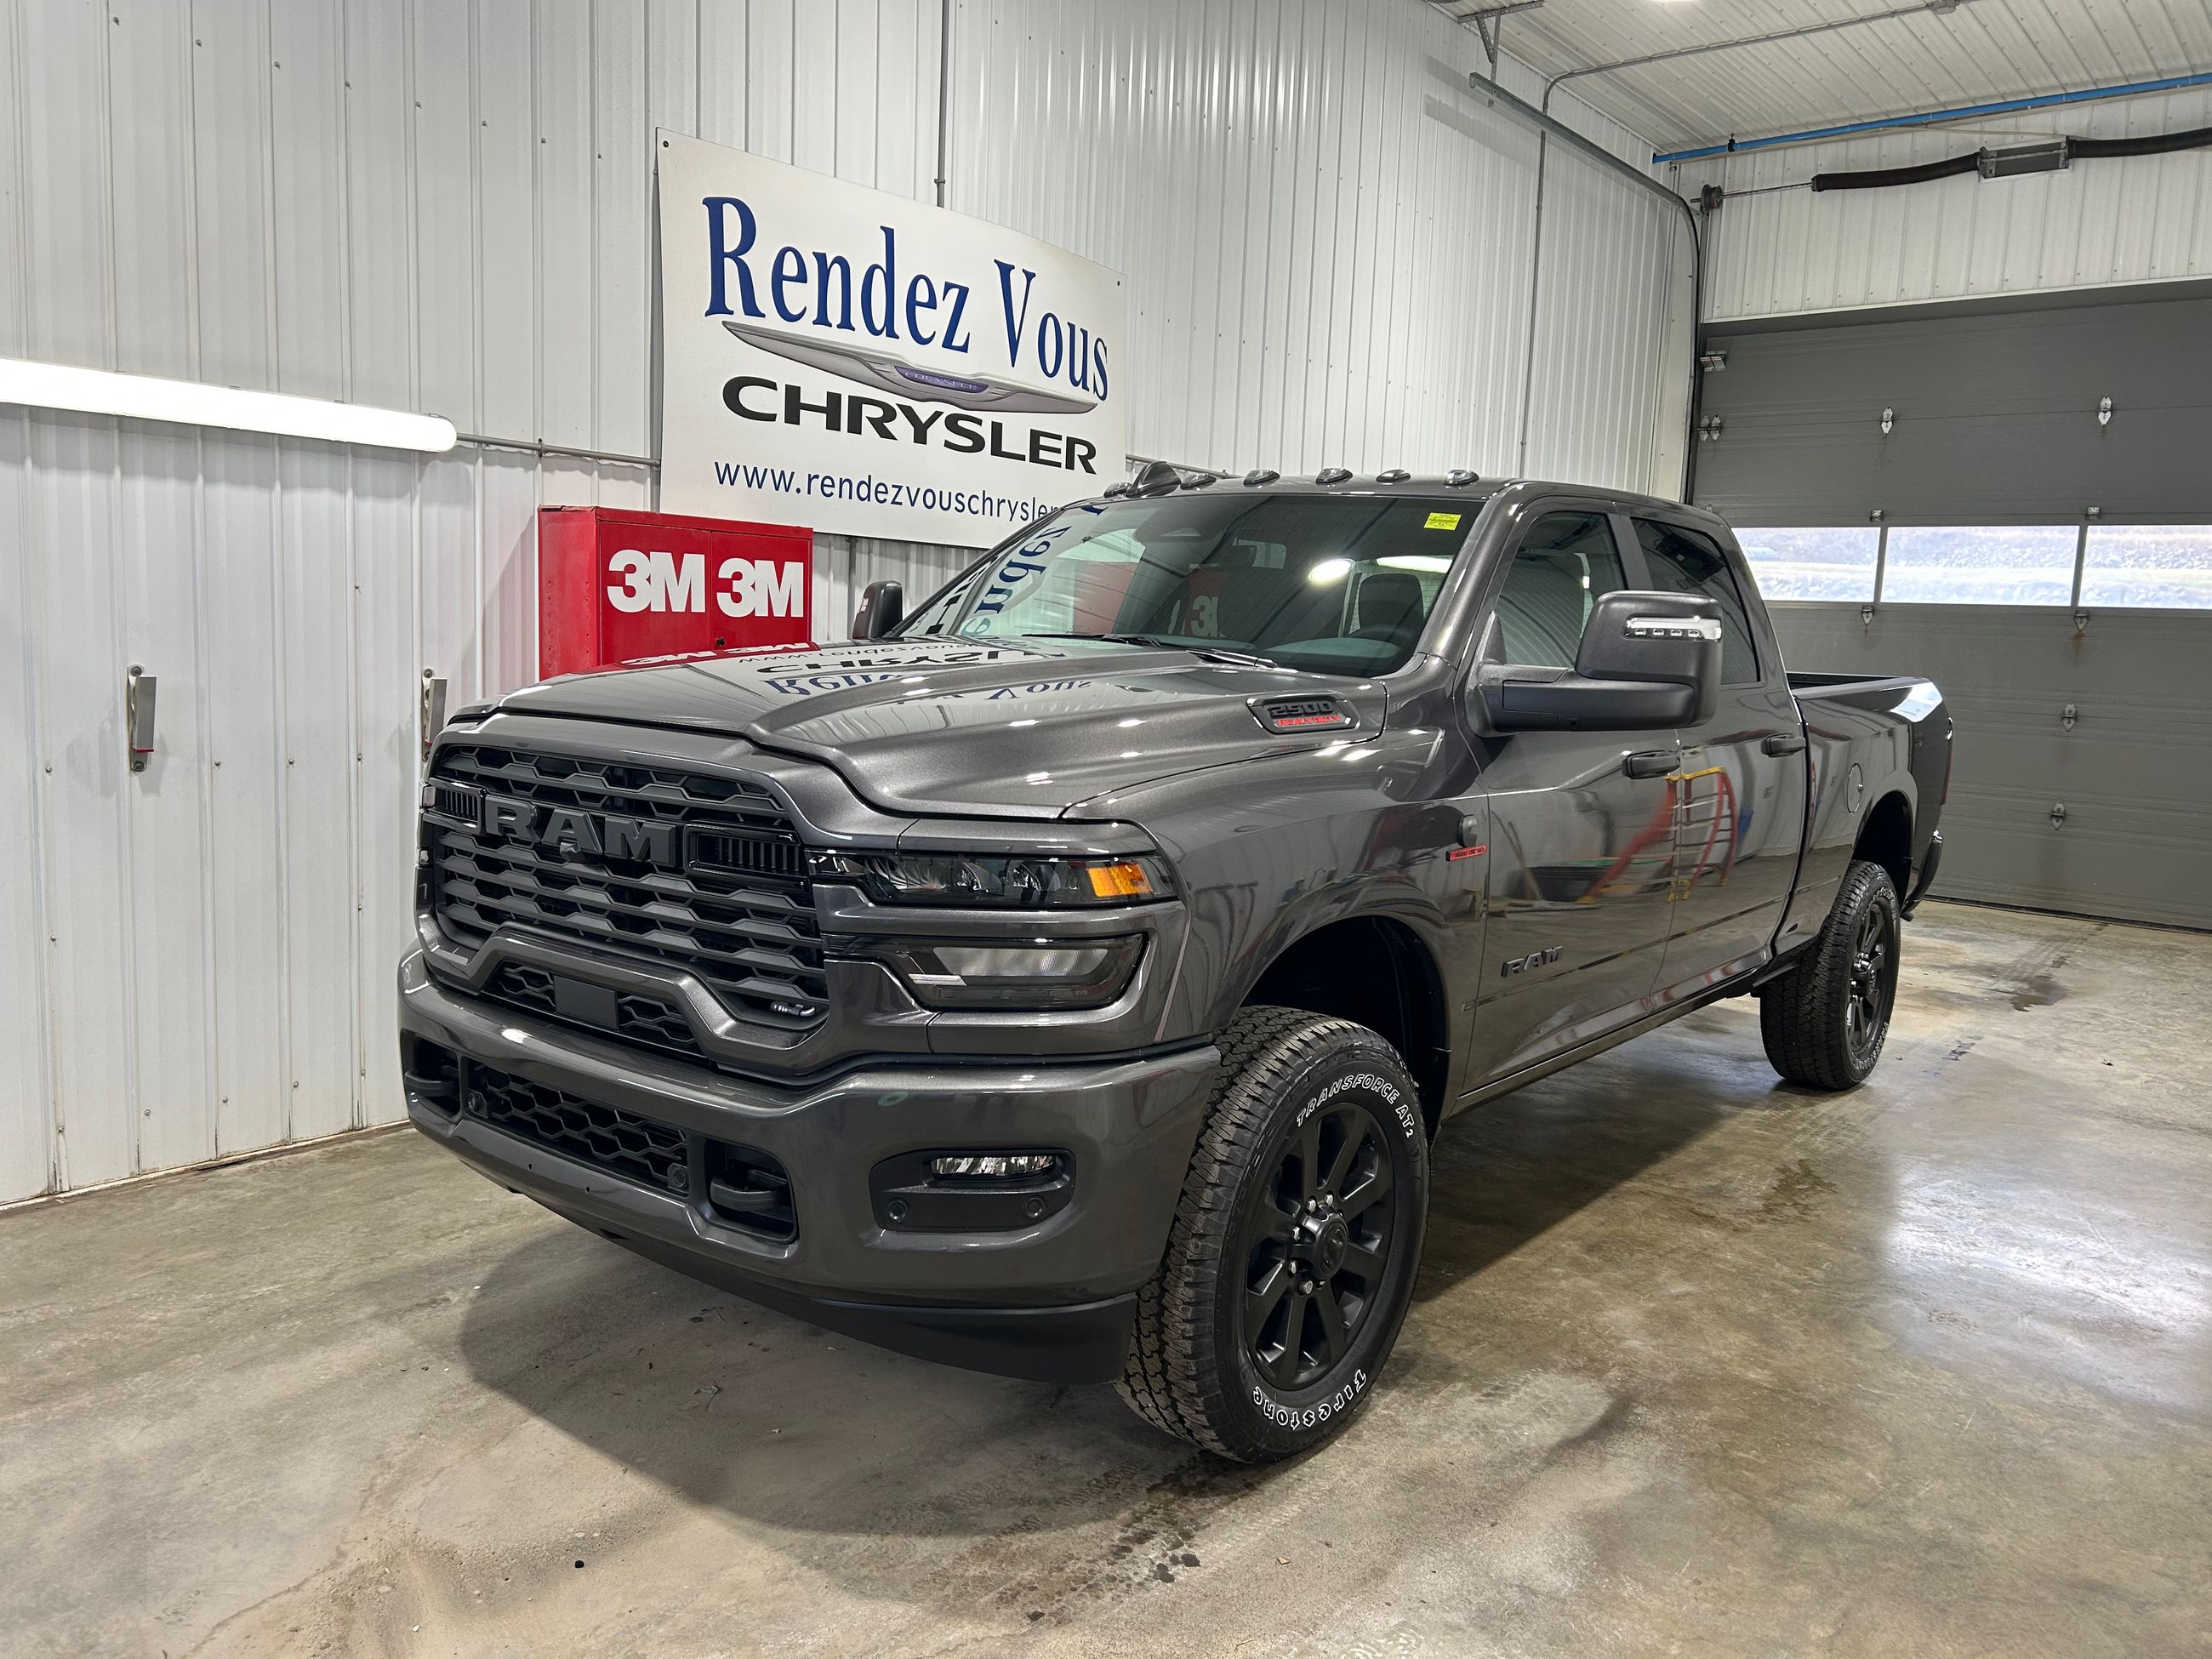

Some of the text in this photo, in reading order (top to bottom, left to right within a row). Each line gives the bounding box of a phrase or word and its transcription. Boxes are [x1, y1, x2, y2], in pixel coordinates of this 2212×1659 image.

[702, 196, 1109, 402] Rendez Vous
[721, 376, 1097, 475] CHRYSLER
[607, 549, 706, 613] 3M
[716, 556, 804, 619] 3M
[1267, 701, 1334, 720] 2500
[484, 795, 677, 867] RAM
[1500, 945, 1564, 978] RAM
[1296, 1074, 1400, 1127] TRANSFORCE
[1252, 1368, 1367, 1431] Firestone
